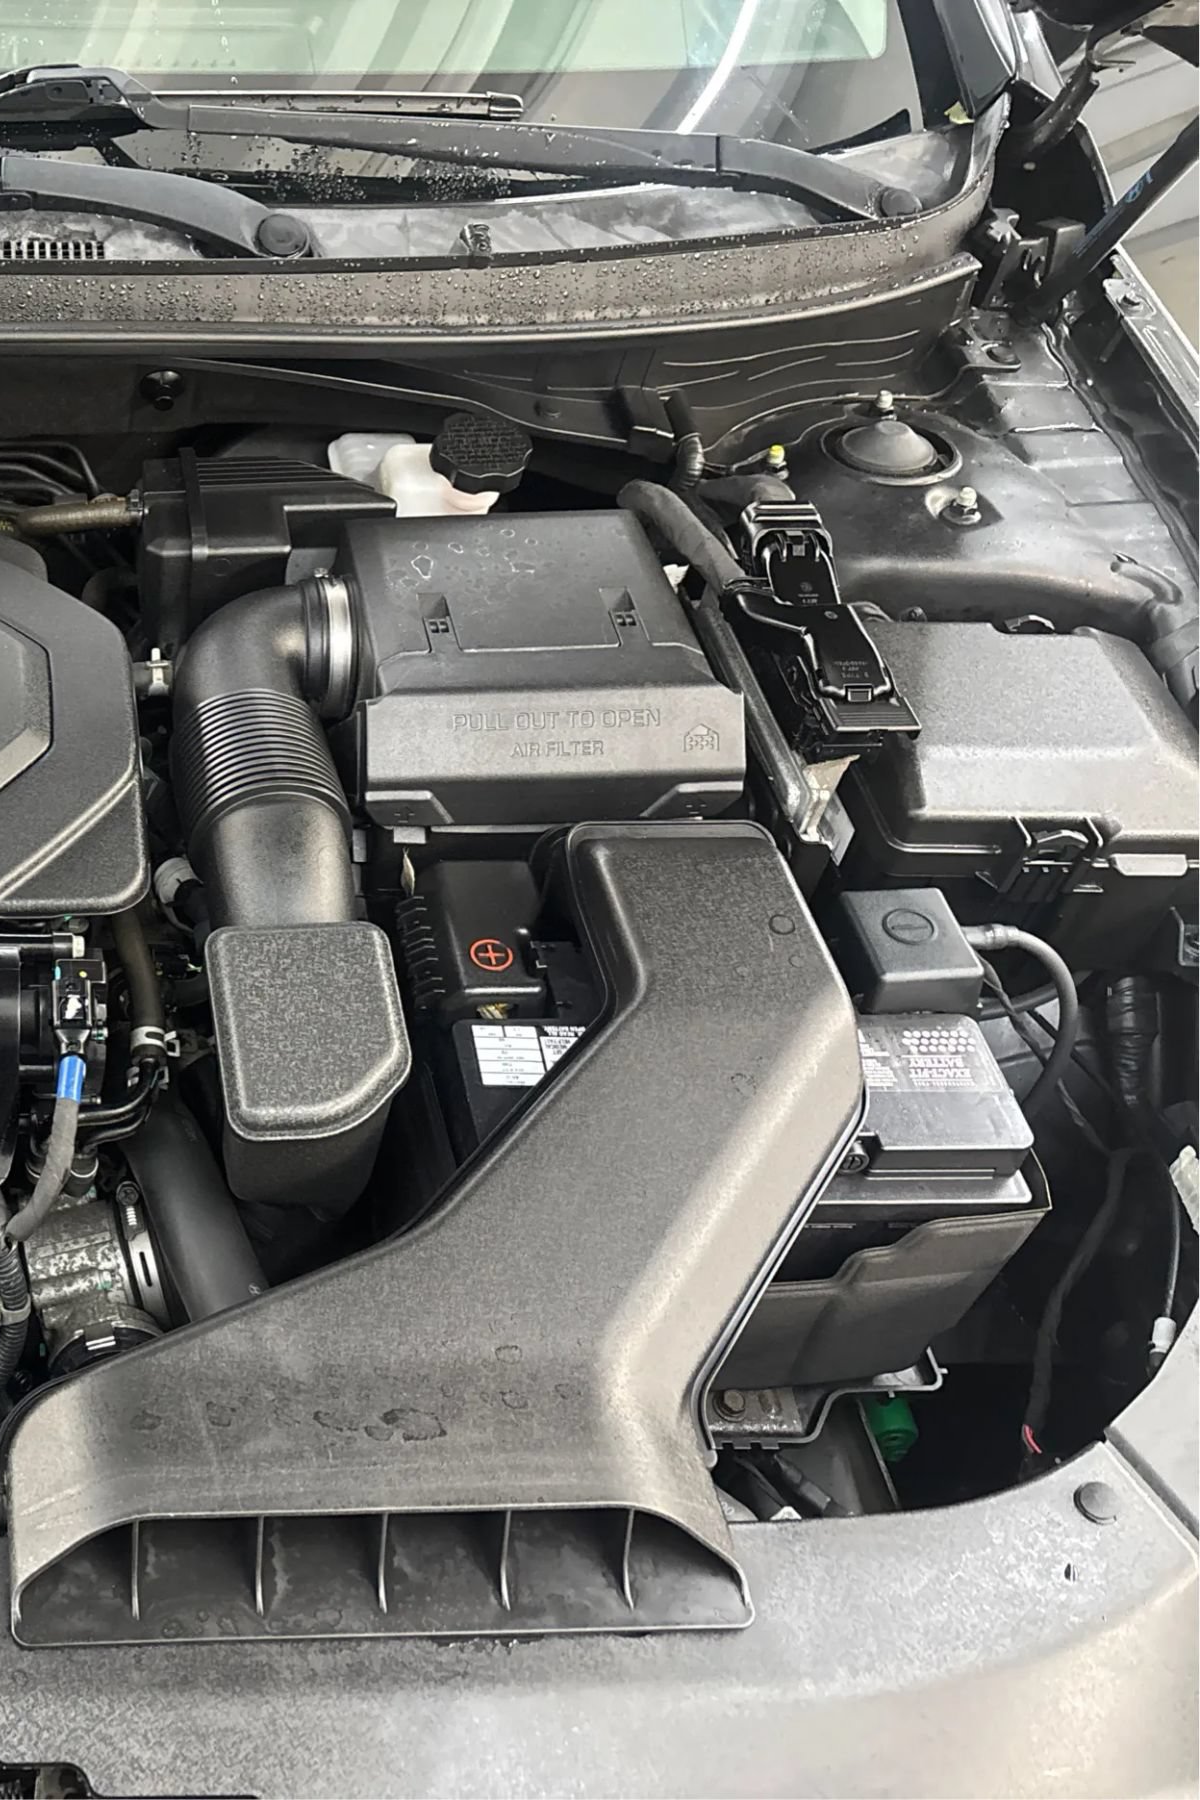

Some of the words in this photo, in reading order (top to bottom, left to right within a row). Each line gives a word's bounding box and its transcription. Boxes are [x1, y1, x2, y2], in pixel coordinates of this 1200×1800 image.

[452, 712, 509, 731] PULL
[514, 711, 560, 730] OUT
[567, 709, 596, 729] TO
[602, 708, 662, 728] OPEN
[511, 741, 541, 758] AIR
[546, 740, 605, 757] FILTER
[908, 1058, 964, 1068] BATTERY
